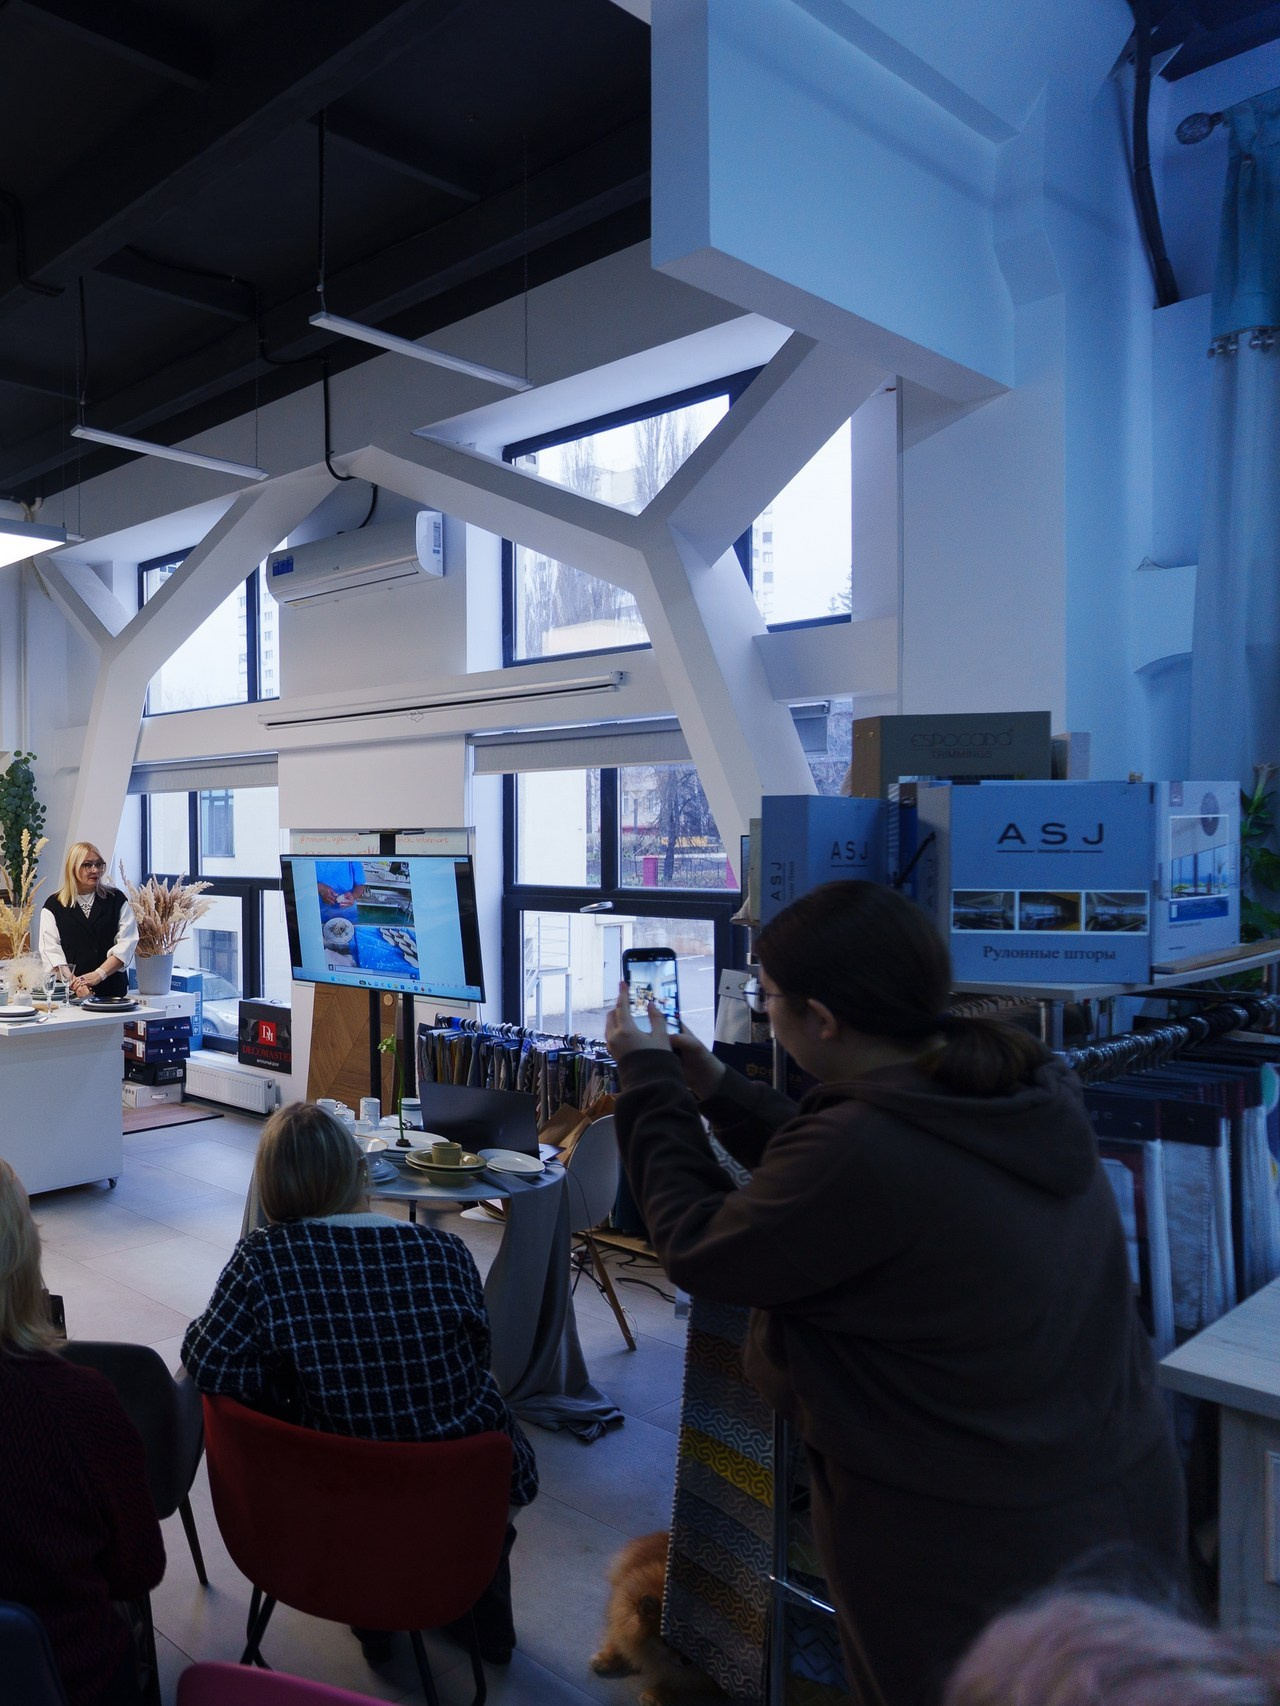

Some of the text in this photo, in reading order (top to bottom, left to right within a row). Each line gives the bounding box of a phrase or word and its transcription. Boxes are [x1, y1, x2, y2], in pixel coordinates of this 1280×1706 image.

[931, 750, 993, 759] TRIMMINGS
[997, 822, 1105, 846] ASJ
[830, 840, 869, 861] ASJ
[770, 862, 782, 902] ASJ
[983, 945, 1116, 963] Рулонные шторы
